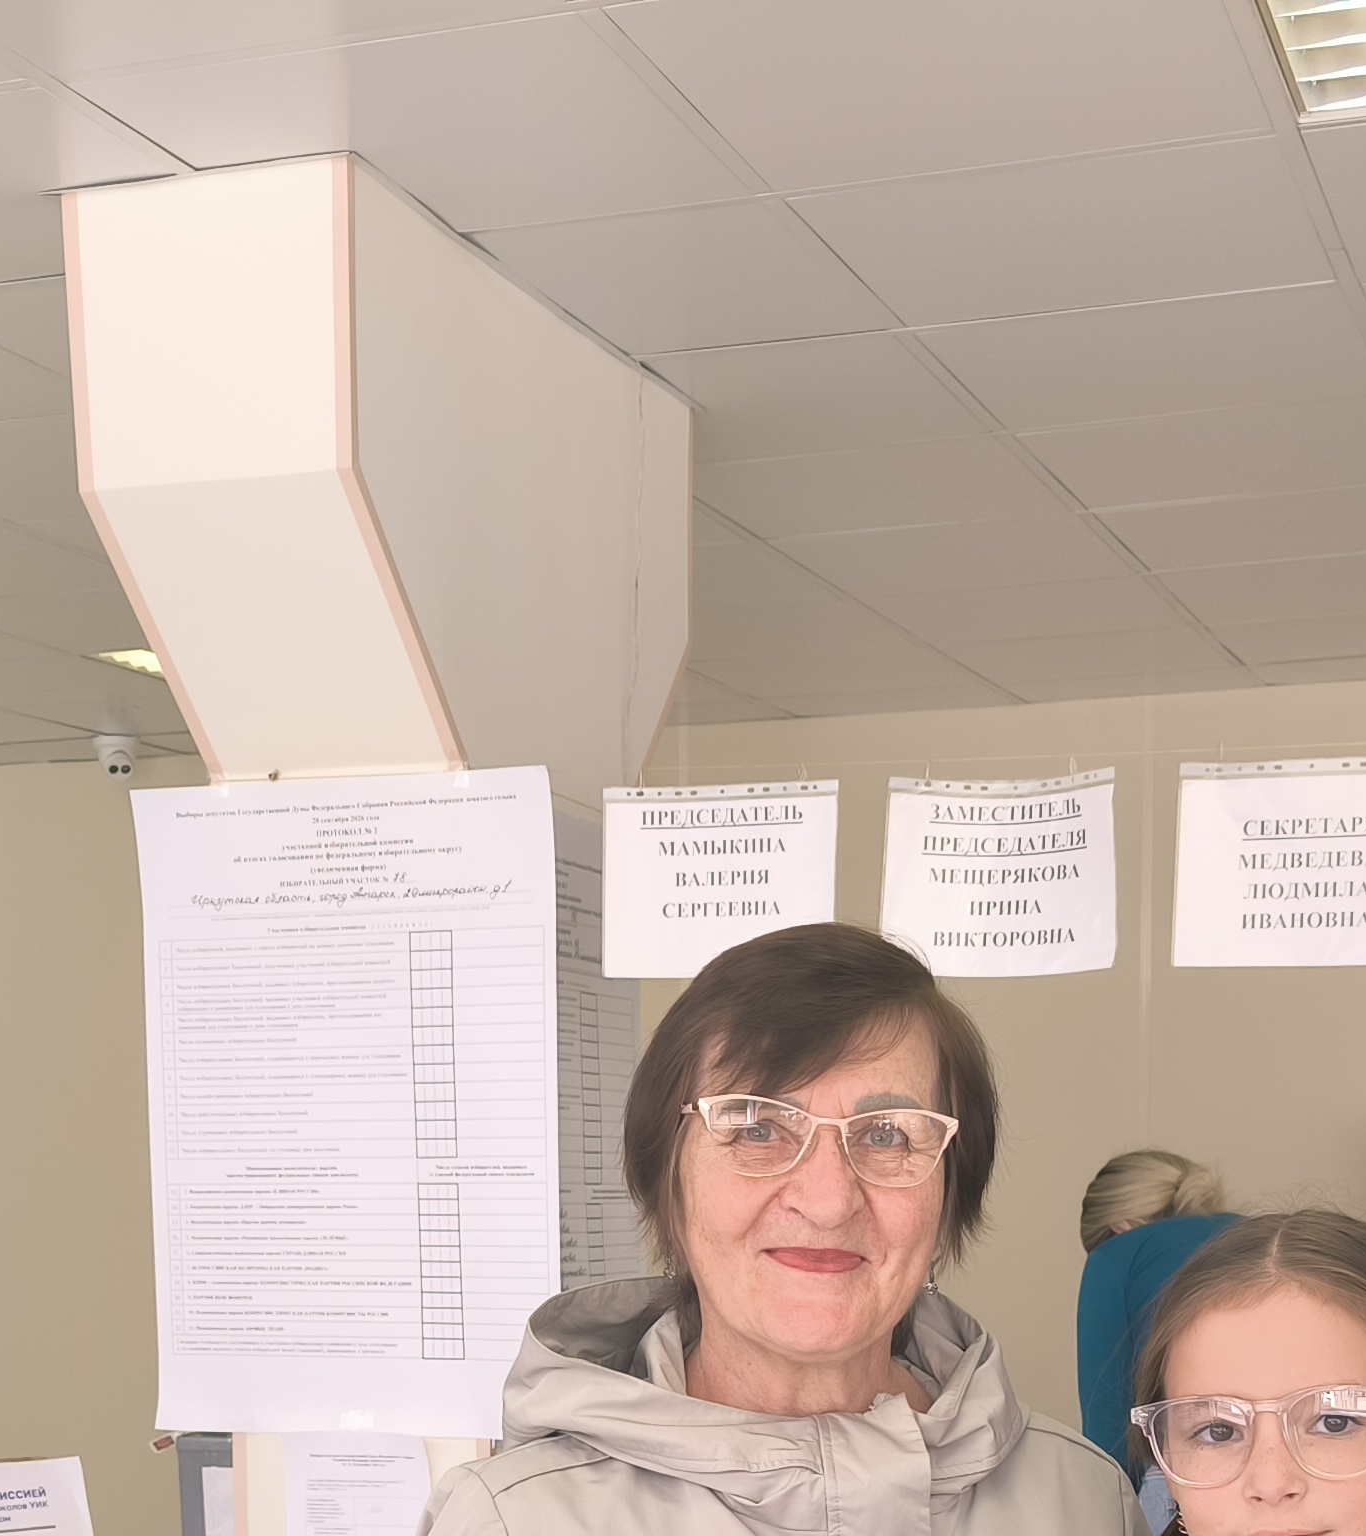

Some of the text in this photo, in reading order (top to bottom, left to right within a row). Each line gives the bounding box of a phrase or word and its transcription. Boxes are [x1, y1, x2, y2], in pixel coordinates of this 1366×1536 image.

[641, 804, 804, 829] ПРЕДСЕДАТЕЛЬ
[930, 798, 1082, 823] ЗАМЕСТИТЕЛЬ
[316, 827, 362, 838] ПРОТОКОЛ
[922, 828, 1087, 857] ПРЕДСЕДАТЕЛЯ
[658, 837, 786, 857] МАМЫКИНА
[675, 869, 769, 887] ВАЛЕРИЯ
[929, 863, 1080, 887] МЕЩЕРЯКОВА
[662, 900, 781, 919] СЕРГЕЕВНА
[969, 899, 1042, 916] ИРИНА
[933, 927, 1075, 947] ВИКТОРОВНА
